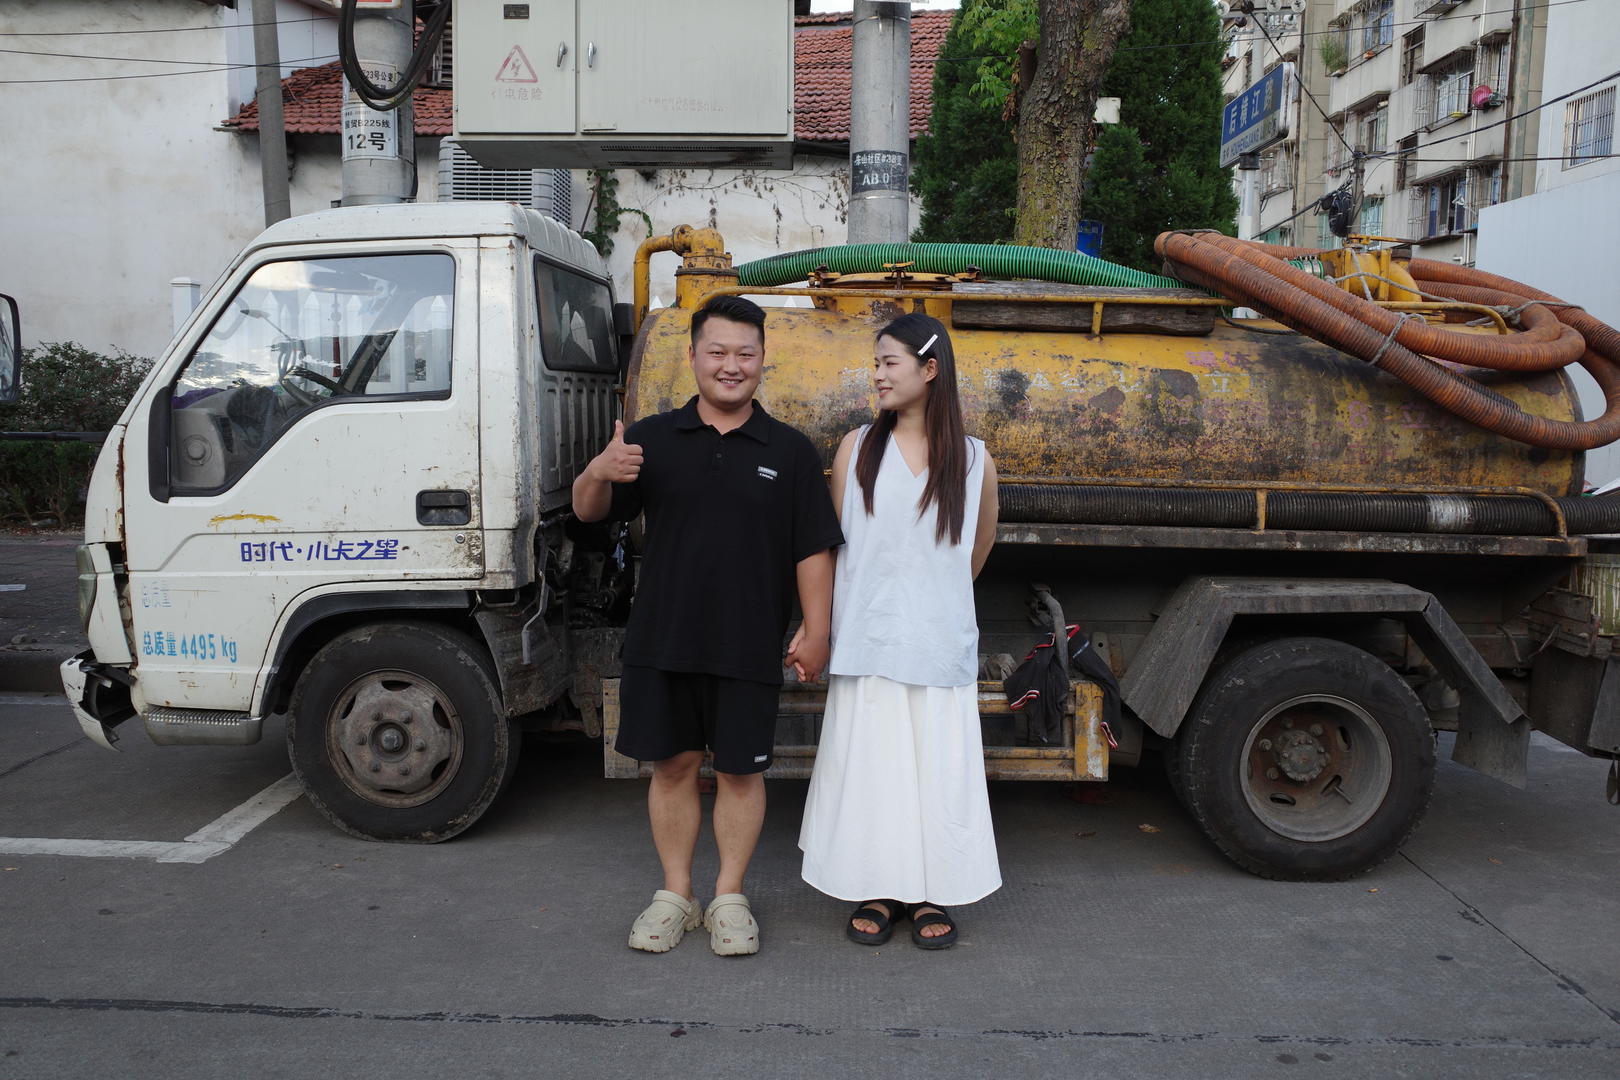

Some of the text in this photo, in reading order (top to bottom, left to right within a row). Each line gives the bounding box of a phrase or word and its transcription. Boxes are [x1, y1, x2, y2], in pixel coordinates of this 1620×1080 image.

[490, 87, 544, 104] 电危险
[1229, 78, 1274, 135] 后横江路
[347, 132, 386, 151] 12号
[240, 538, 399, 562] 时代·小卡之星
[143, 630, 237, 663] 总质量 4495 kg
